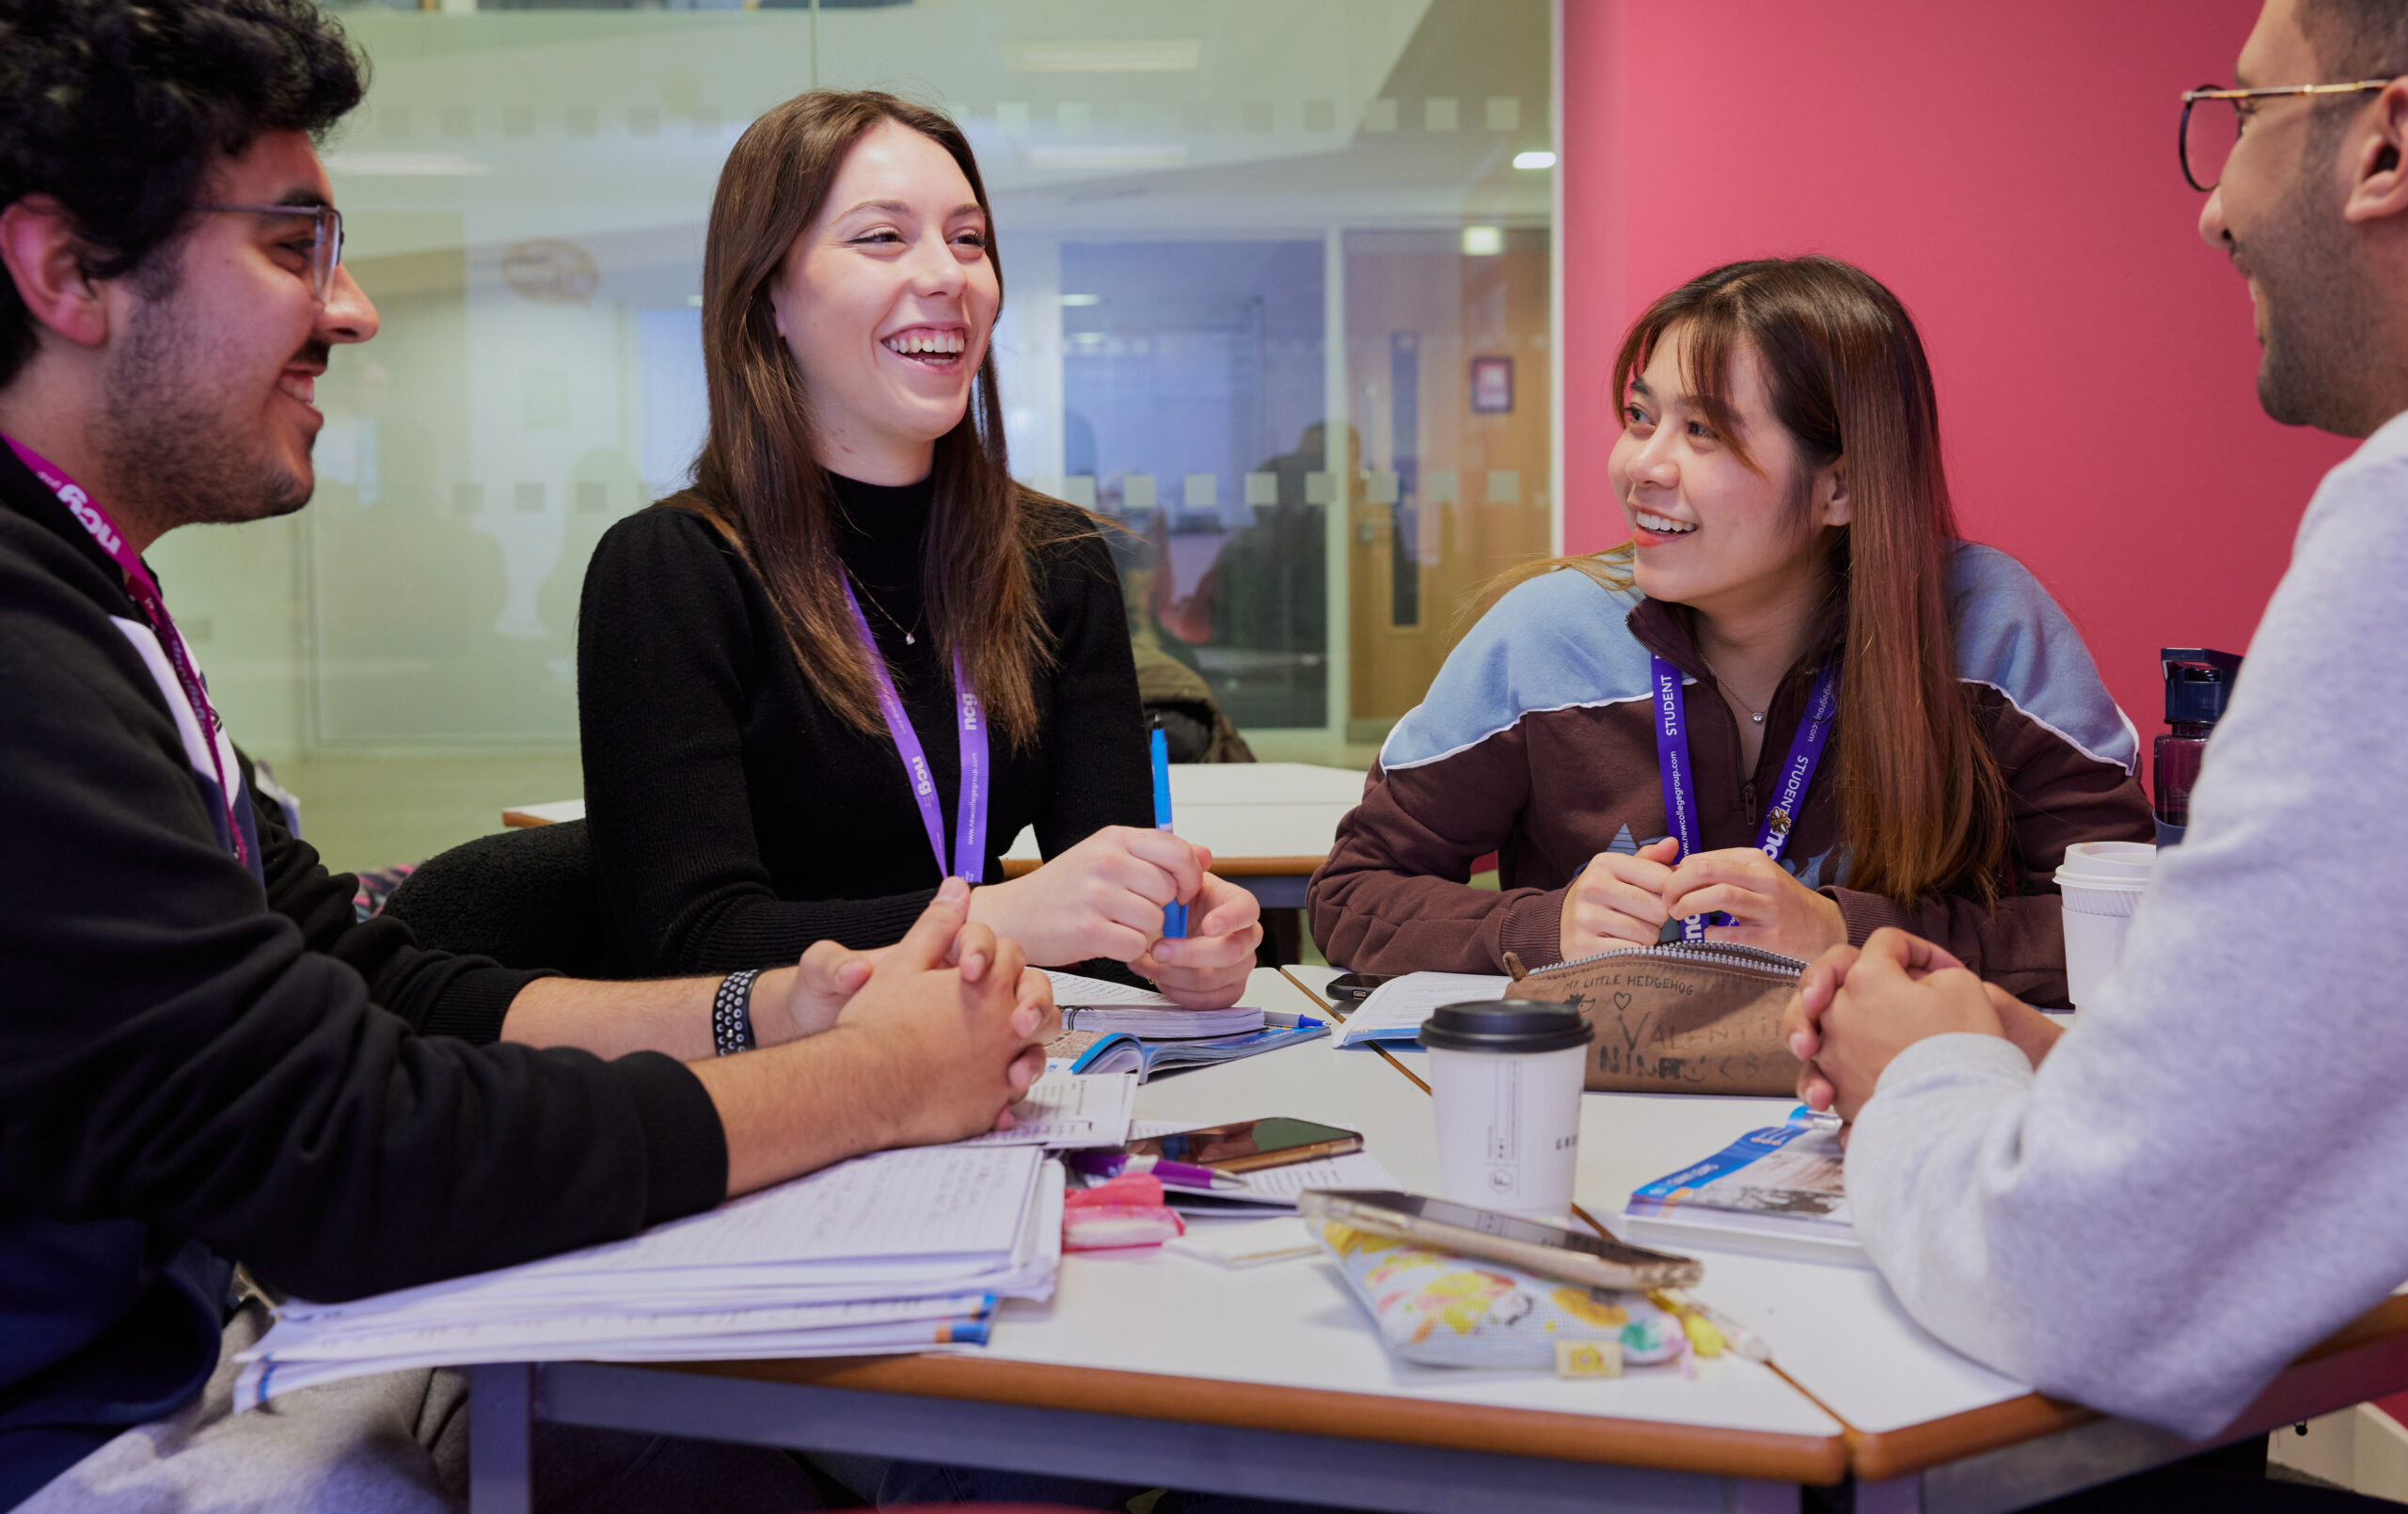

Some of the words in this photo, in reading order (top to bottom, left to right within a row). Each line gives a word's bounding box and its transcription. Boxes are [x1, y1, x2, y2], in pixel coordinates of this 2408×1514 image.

[961, 692, 979, 732] ncg
[1660, 674, 1678, 736] STUDENT
[911, 755, 933, 796] ncg
[967, 752, 978, 845] www.newcollegegroup.com
[1670, 750, 1690, 858] ww.newcollegegroup.com
[1762, 828, 1786, 860] nc
[1684, 913, 1703, 939] nc
[1584, 974, 1622, 988] LITTLE
[1627, 975, 1694, 996] HEDGEHOG
